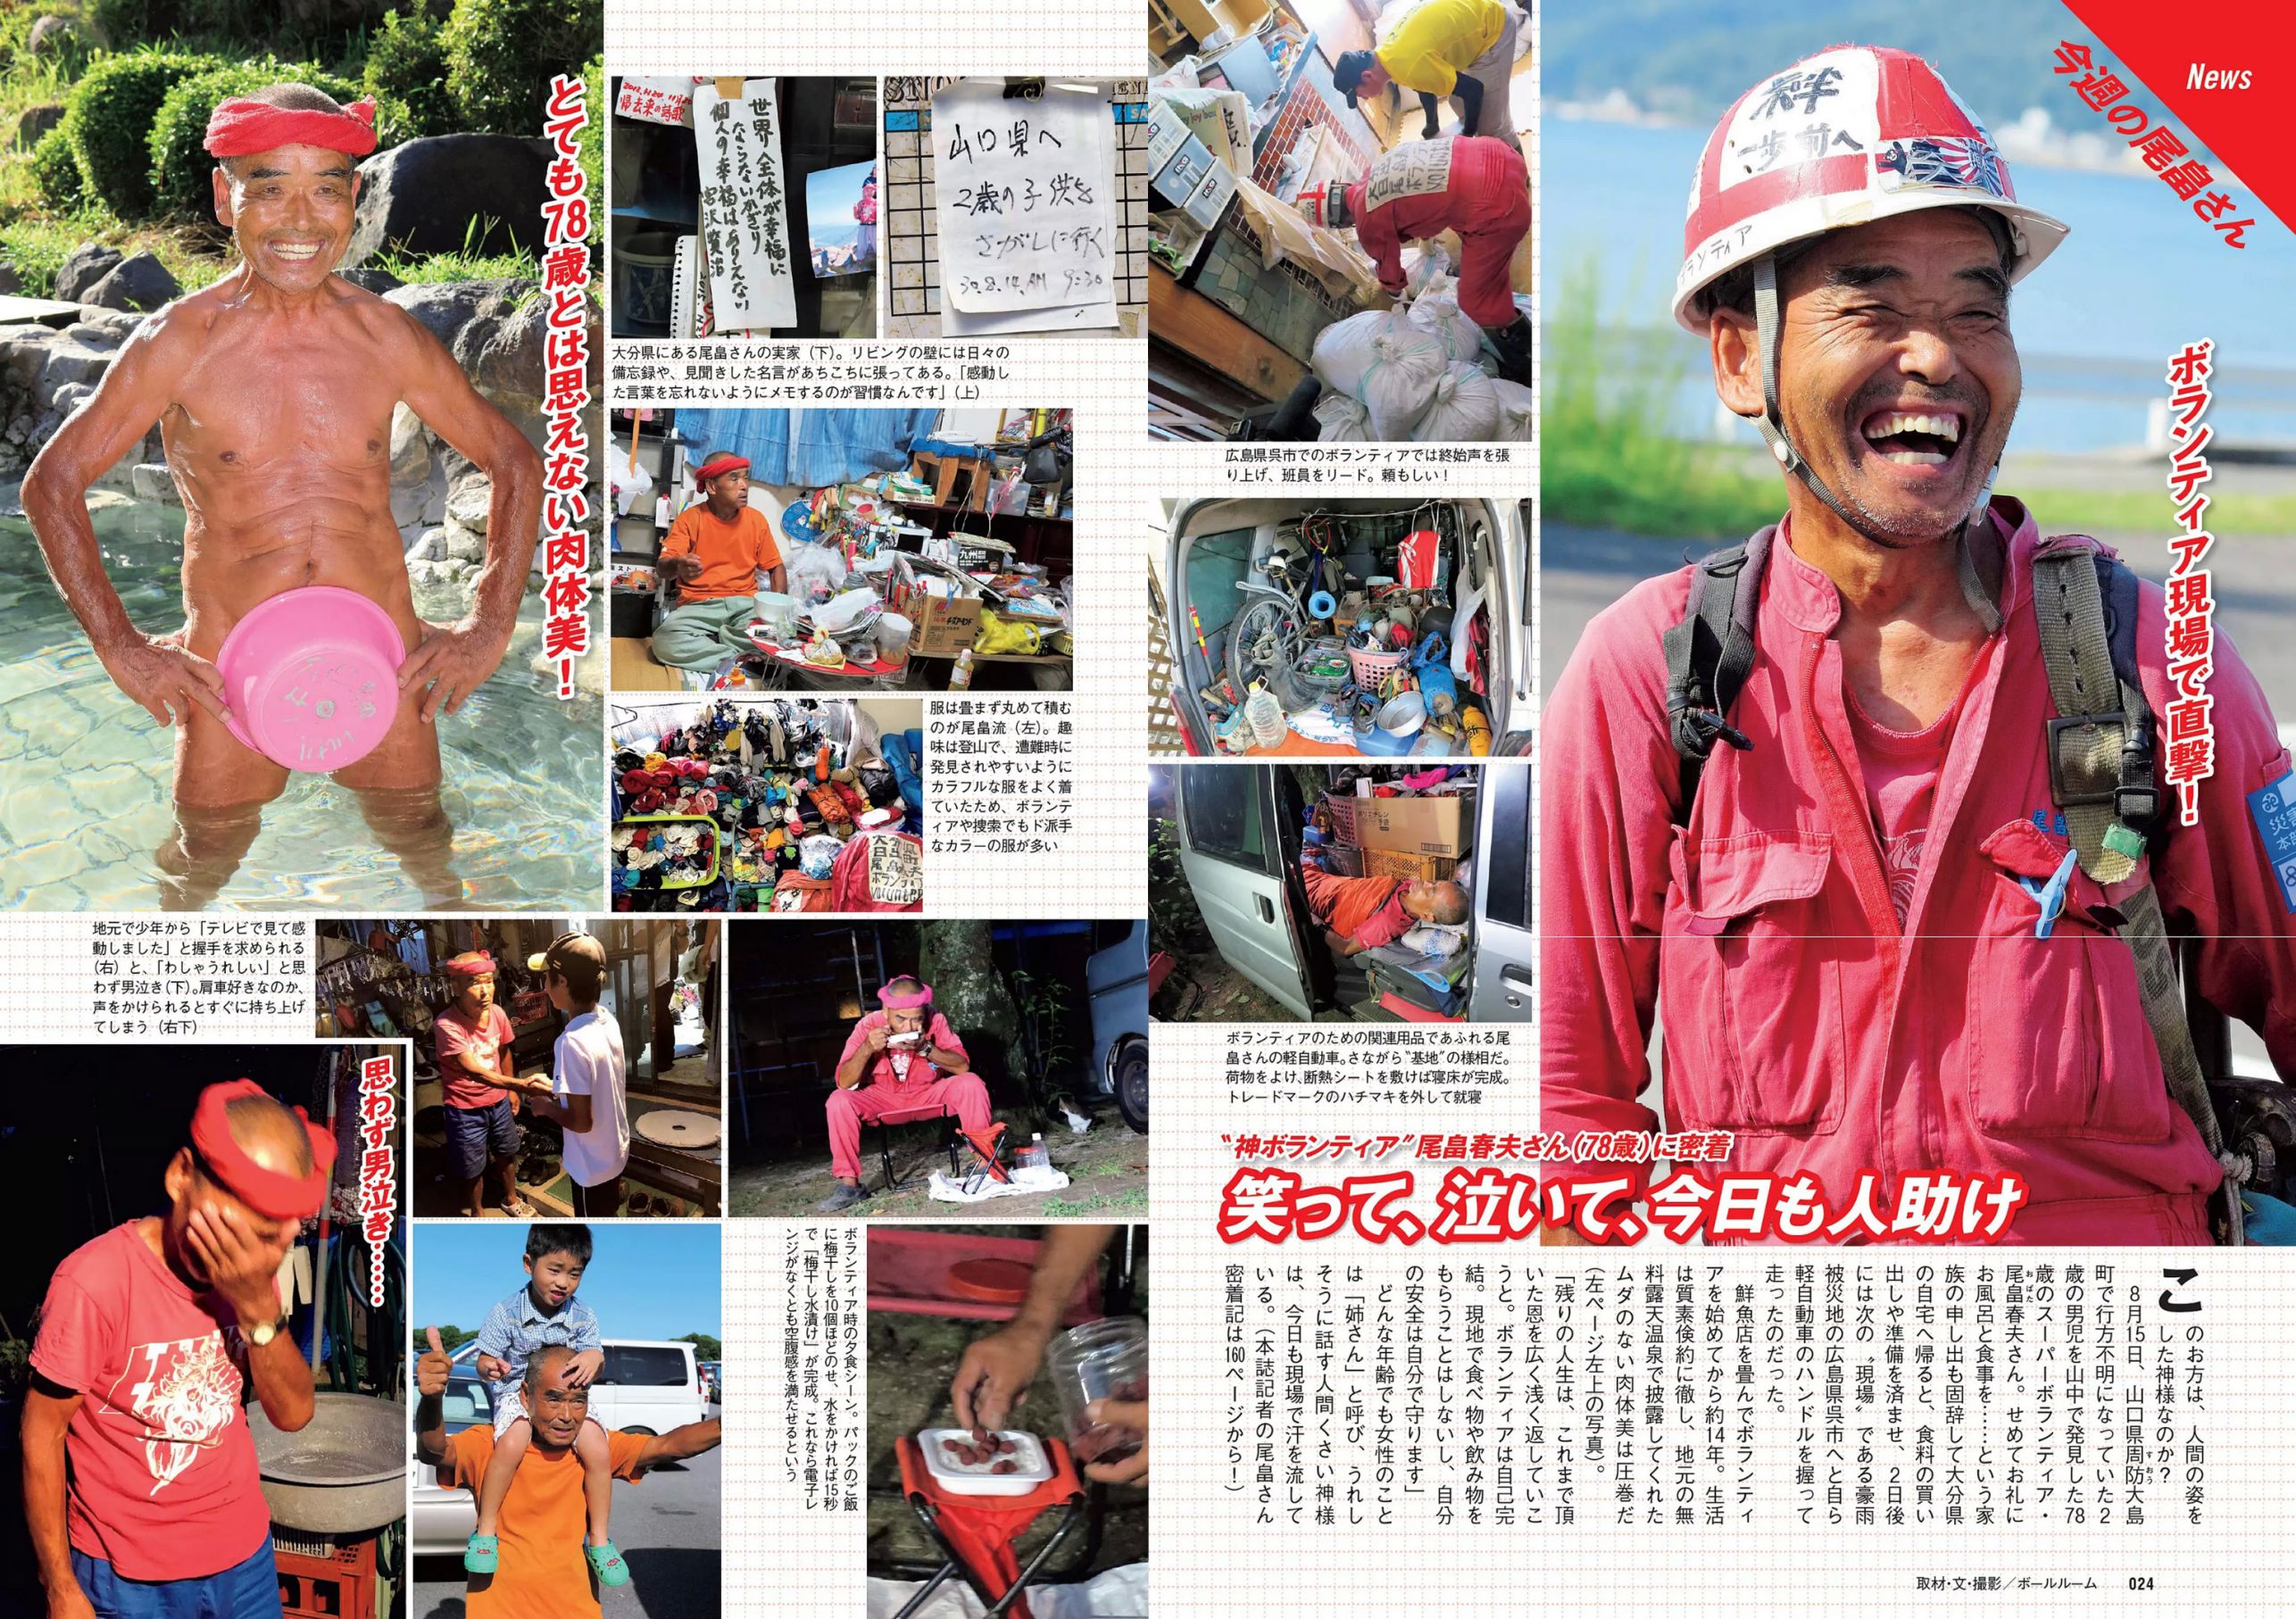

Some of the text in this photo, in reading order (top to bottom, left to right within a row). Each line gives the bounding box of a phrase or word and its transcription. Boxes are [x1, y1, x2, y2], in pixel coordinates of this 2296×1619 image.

[949, 120, 1062, 164] 山口県へ
[953, 173, 1094, 215] 2歳の子供を
[1736, 123, 1865, 172] 一歩前へ
[976, 226, 1105, 260] さがしに行く
[612, 345, 1010, 360] 大分県にある尾畠さんの実家（下）。リビングの壁には日々の
[612, 365, 1010, 380] 備忘録や、見聞きした名言があちこちに張ってある。「感動し
[613, 385, 980, 400] た言葉を忘れないようにメモするのが習慣なんです」（上）
[1226, 448, 1510, 462] 広島県呉市でのボランティアでは終始声を張
[1227, 468, 1448, 482] り上げ、班員をリード。頼もしい！
[930, 701, 1072, 715] 服は畳まず丸めて積む
[930, 720, 1073, 735] のが尾畠流（左）。趣
[930, 740, 1072, 754] 味は登山で、遭難時に
[930, 760, 1072, 774] 発見されやすいように
[931, 779, 1072, 793] カラフルな服をよく着
[931, 800, 1072, 814] ていたため、ボランテ
[931, 839, 1059, 853] なカラーの服が多い
[932, 818, 1073, 834] ィアや捜索でもド派手
[92, 921, 306, 935] 地元で少年から「テレビで見て感
[92, 941, 304, 955] 動しました」と握手を求められる
[93, 1000, 306, 1015] 声をかけられるとすぐに持ち上げ
[94, 980, 304, 994] わず男泣き（下）。肩車好きなのか、
[94, 1020, 197, 1034] てしまう（右下）
[95, 960, 306, 975] （右）と、「わしゃうれしい」と思
[1226, 1070, 1510, 1085] 荷物をよけ、断熱シートを敷けば寝床が完成。
[1227, 1031, 1510, 1045] ボランティアのための関連用品であふれる尾
[1229, 1090, 1482, 1104] トレードマークのハチマキを外して就寝
[784, 1228, 799, 1482] ンジがなくとも空腹感を満たせるという
[803, 1228, 819, 1510] で「梅干し水漬け」が完成。これなら電子レ
[823, 1228, 839, 1512] に梅干しを10個ほどのせ、水をかければ15秒
[843, 1228, 859, 1512] ボランティア時の夕食シーン。パックのご飯
[1224, 1264, 1245, 1491] 密着記は160ページから！）
[1404, 1266, 1425, 1492] の安全は自分で守ります」
[1585, 1267, 1606, 1474] （左ページ左上の写真）。
[1765, 1264, 1784, 1413] 走ったのだった。
[2026, 1270, 2034, 1303] おばた
[2159, 1267, 2202, 1313] こ
[1255, 1267, 1276, 1524] いる。（本誌記者の尾畠さん
[1285, 1266, 1305, 1524] は、今日も現場で汗を流して
[1315, 1266, 1335, 1525] そうに話す人間くさい神様
[1344, 1266, 1366, 1524] は「姉さん」と呼び、うれし
[1375, 1284, 1395, 1524] どんな年齢でも女性のこと
[1435, 1265, 1455, 1525] もらうことはしないし、自分
[1465, 1264, 1485, 1524] 結。現地で食べ物や飲み物を
[1495, 1265, 1515, 1525] うと。ボランティアは自己完
[1525, 1267, 1545, 1524] いた恩を広く浅く返していこ
[1554, 1276, 1576, 1525] 「残りの人生は、これまで頂
[1614, 1266, 1635, 1524] ムダのない肉体美は圧巻だ
[1644, 1264, 1665, 1524] 料露天温泉で披露してくれた
[1675, 1266, 1695, 1524] は質素倹約に徹し、地元の無
[1705, 1266, 1726, 1525] アを始めてから約14年。生活
[1734, 1283, 1755, 1524] 鮮魚店を畳んでボランティ
[1794, 1264, 1815, 1524] 軽自動車のハンドルを握って
[1825, 1264, 1845, 1524] 被災地の広島県呉市へと自ら
[1884, 1264, 1905, 1525] 出しや準備を済ませ、2日後
[1915, 1266, 1935, 1524] の自宅へ帰ると、食料の買い
[1945, 1264, 1965, 1525] 族の申し出も固辞して大分県
[2005, 1265, 2026, 1524] 尾畠春夫さん。せめてお礼に
[2035, 1264, 2056, 1518] 歳のスーパーボランティア・
[2065, 1264, 2085, 1524] 歳の男児を山中で発見した78
[2095, 1265, 2116, 1524] 町で行方不明になっていた2
[2125, 1285, 2145, 1524] 8月15日、山口県周防大島
[2155, 1325, 2175, 1485] した神様なのか？
[2185, 1324, 2205, 1524] のお方は、人間の姿を
[1916, 1576, 2097, 1591] 取材・文・撮影／ボールルーム
[2128, 1577, 2154, 1590] 024
